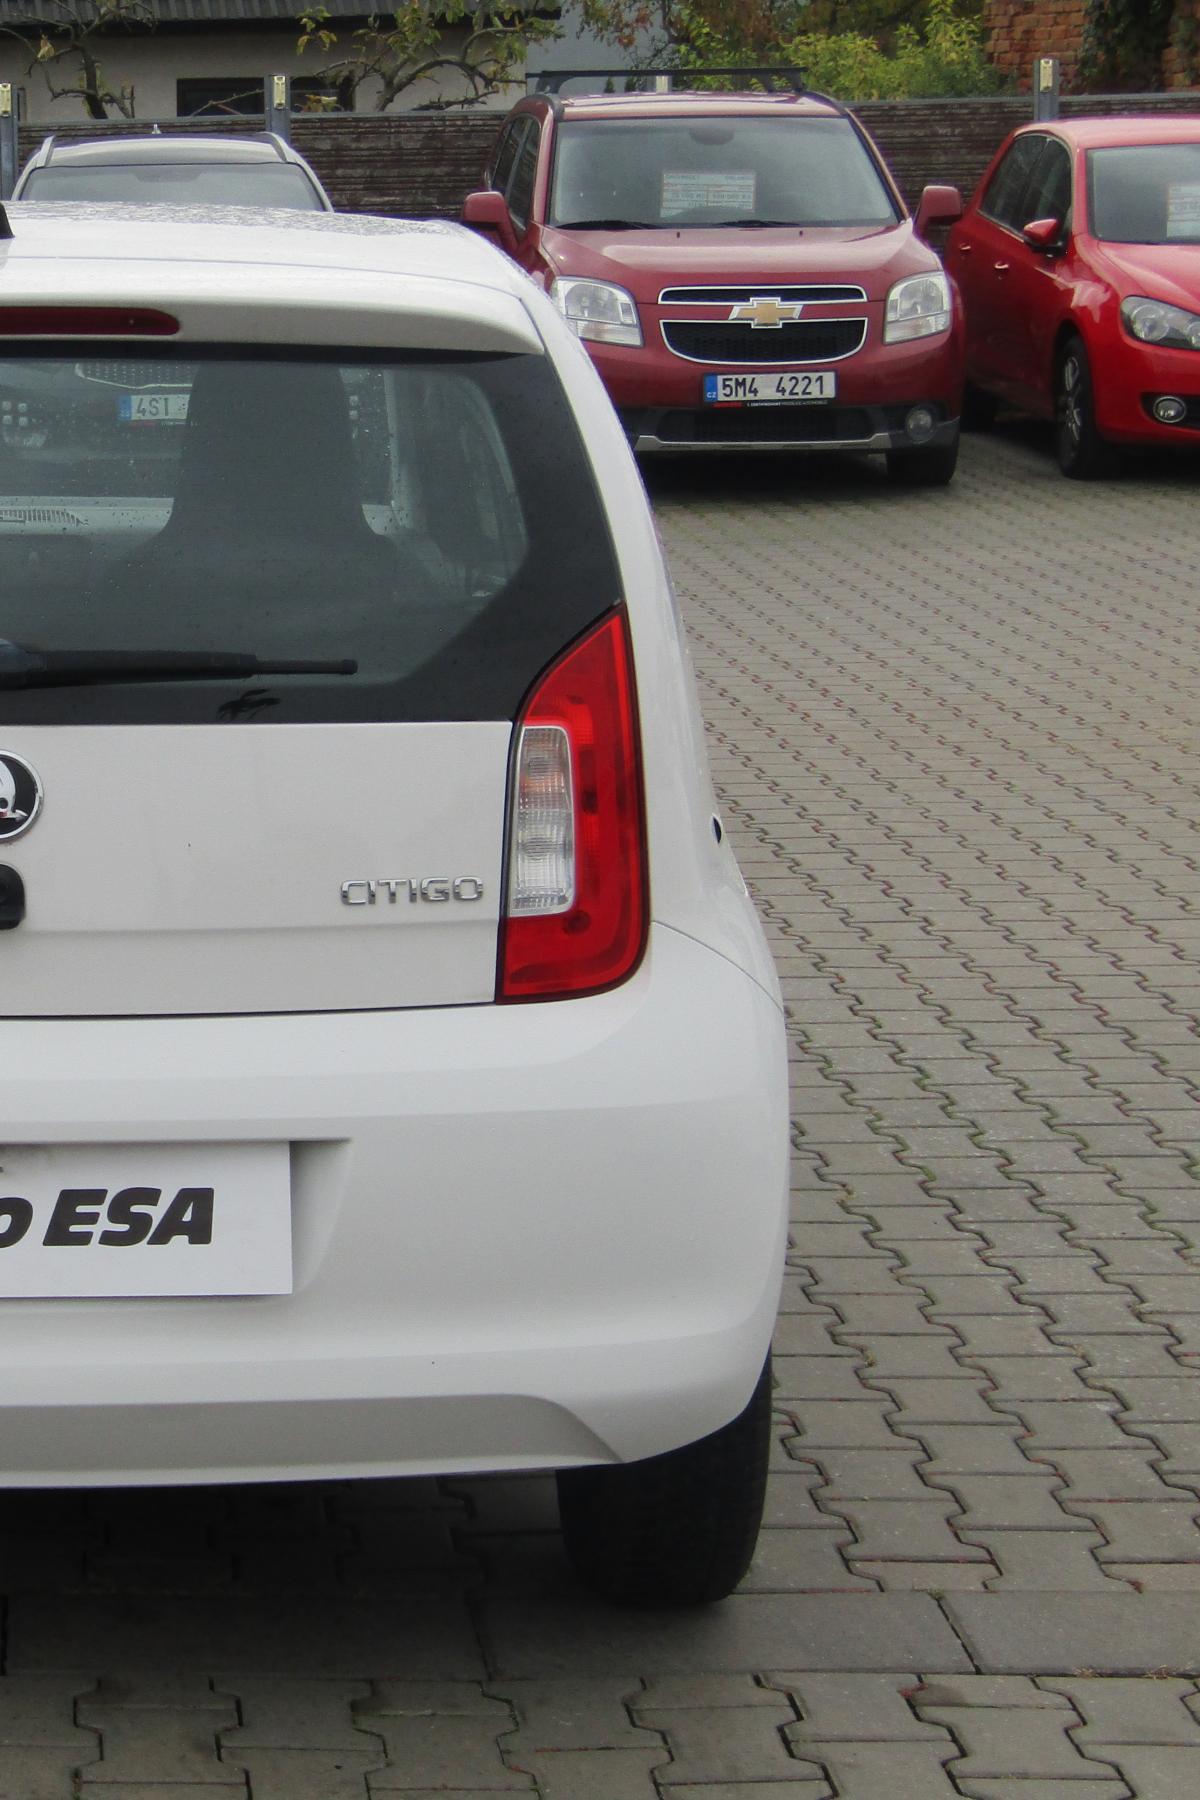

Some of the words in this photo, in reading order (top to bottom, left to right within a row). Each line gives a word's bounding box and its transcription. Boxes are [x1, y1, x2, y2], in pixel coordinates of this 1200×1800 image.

[722, 377, 759, 397] 5M4
[775, 375, 823, 396] 4221
[340, 876, 484, 905] CITIGO
[42, 1187, 215, 1247] ESA
